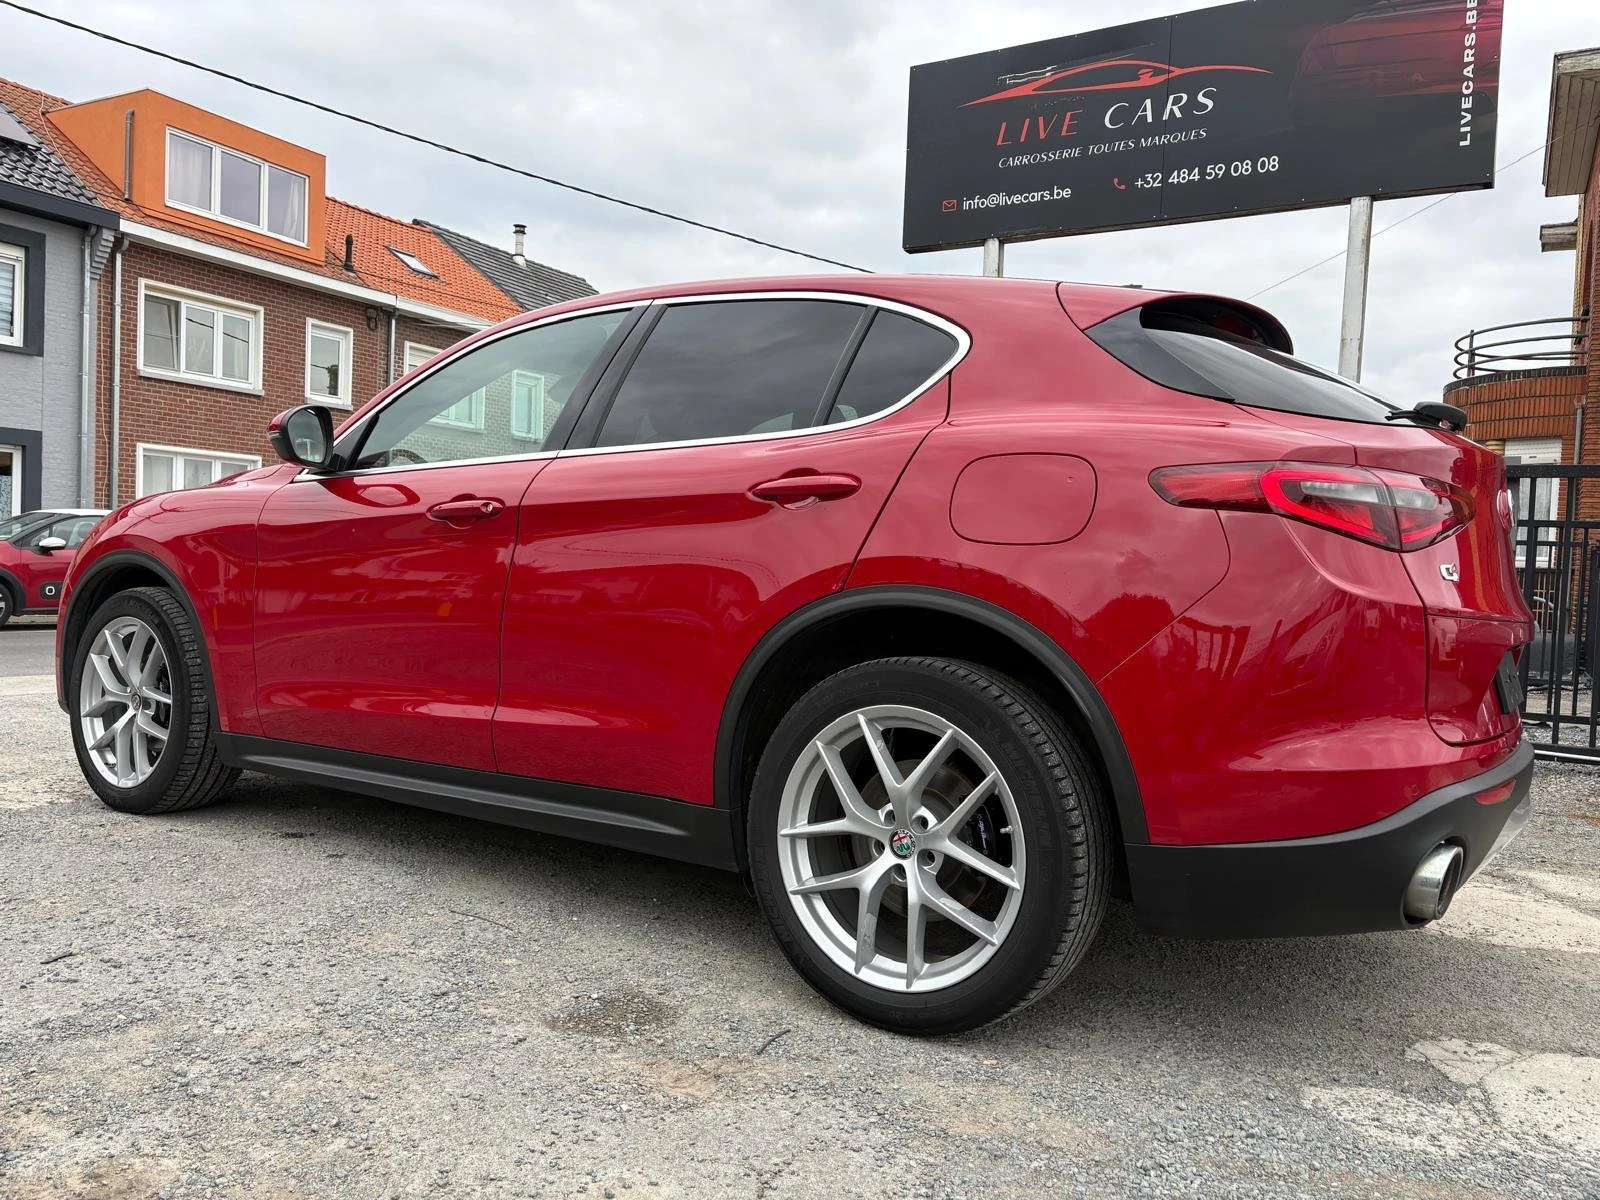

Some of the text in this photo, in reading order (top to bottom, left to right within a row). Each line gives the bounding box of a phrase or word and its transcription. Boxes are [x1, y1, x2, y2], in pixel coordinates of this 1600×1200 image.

[1459, 0, 1478, 147] LIVECARS.BE
[996, 87, 1217, 146] LIVE CARS
[998, 127, 1208, 168] CARROSSERIE TOUTES MARQUES
[1134, 155, 1279, 188] +32 484 59 08 08
[963, 185, 1072, 210] info@livecars.be
